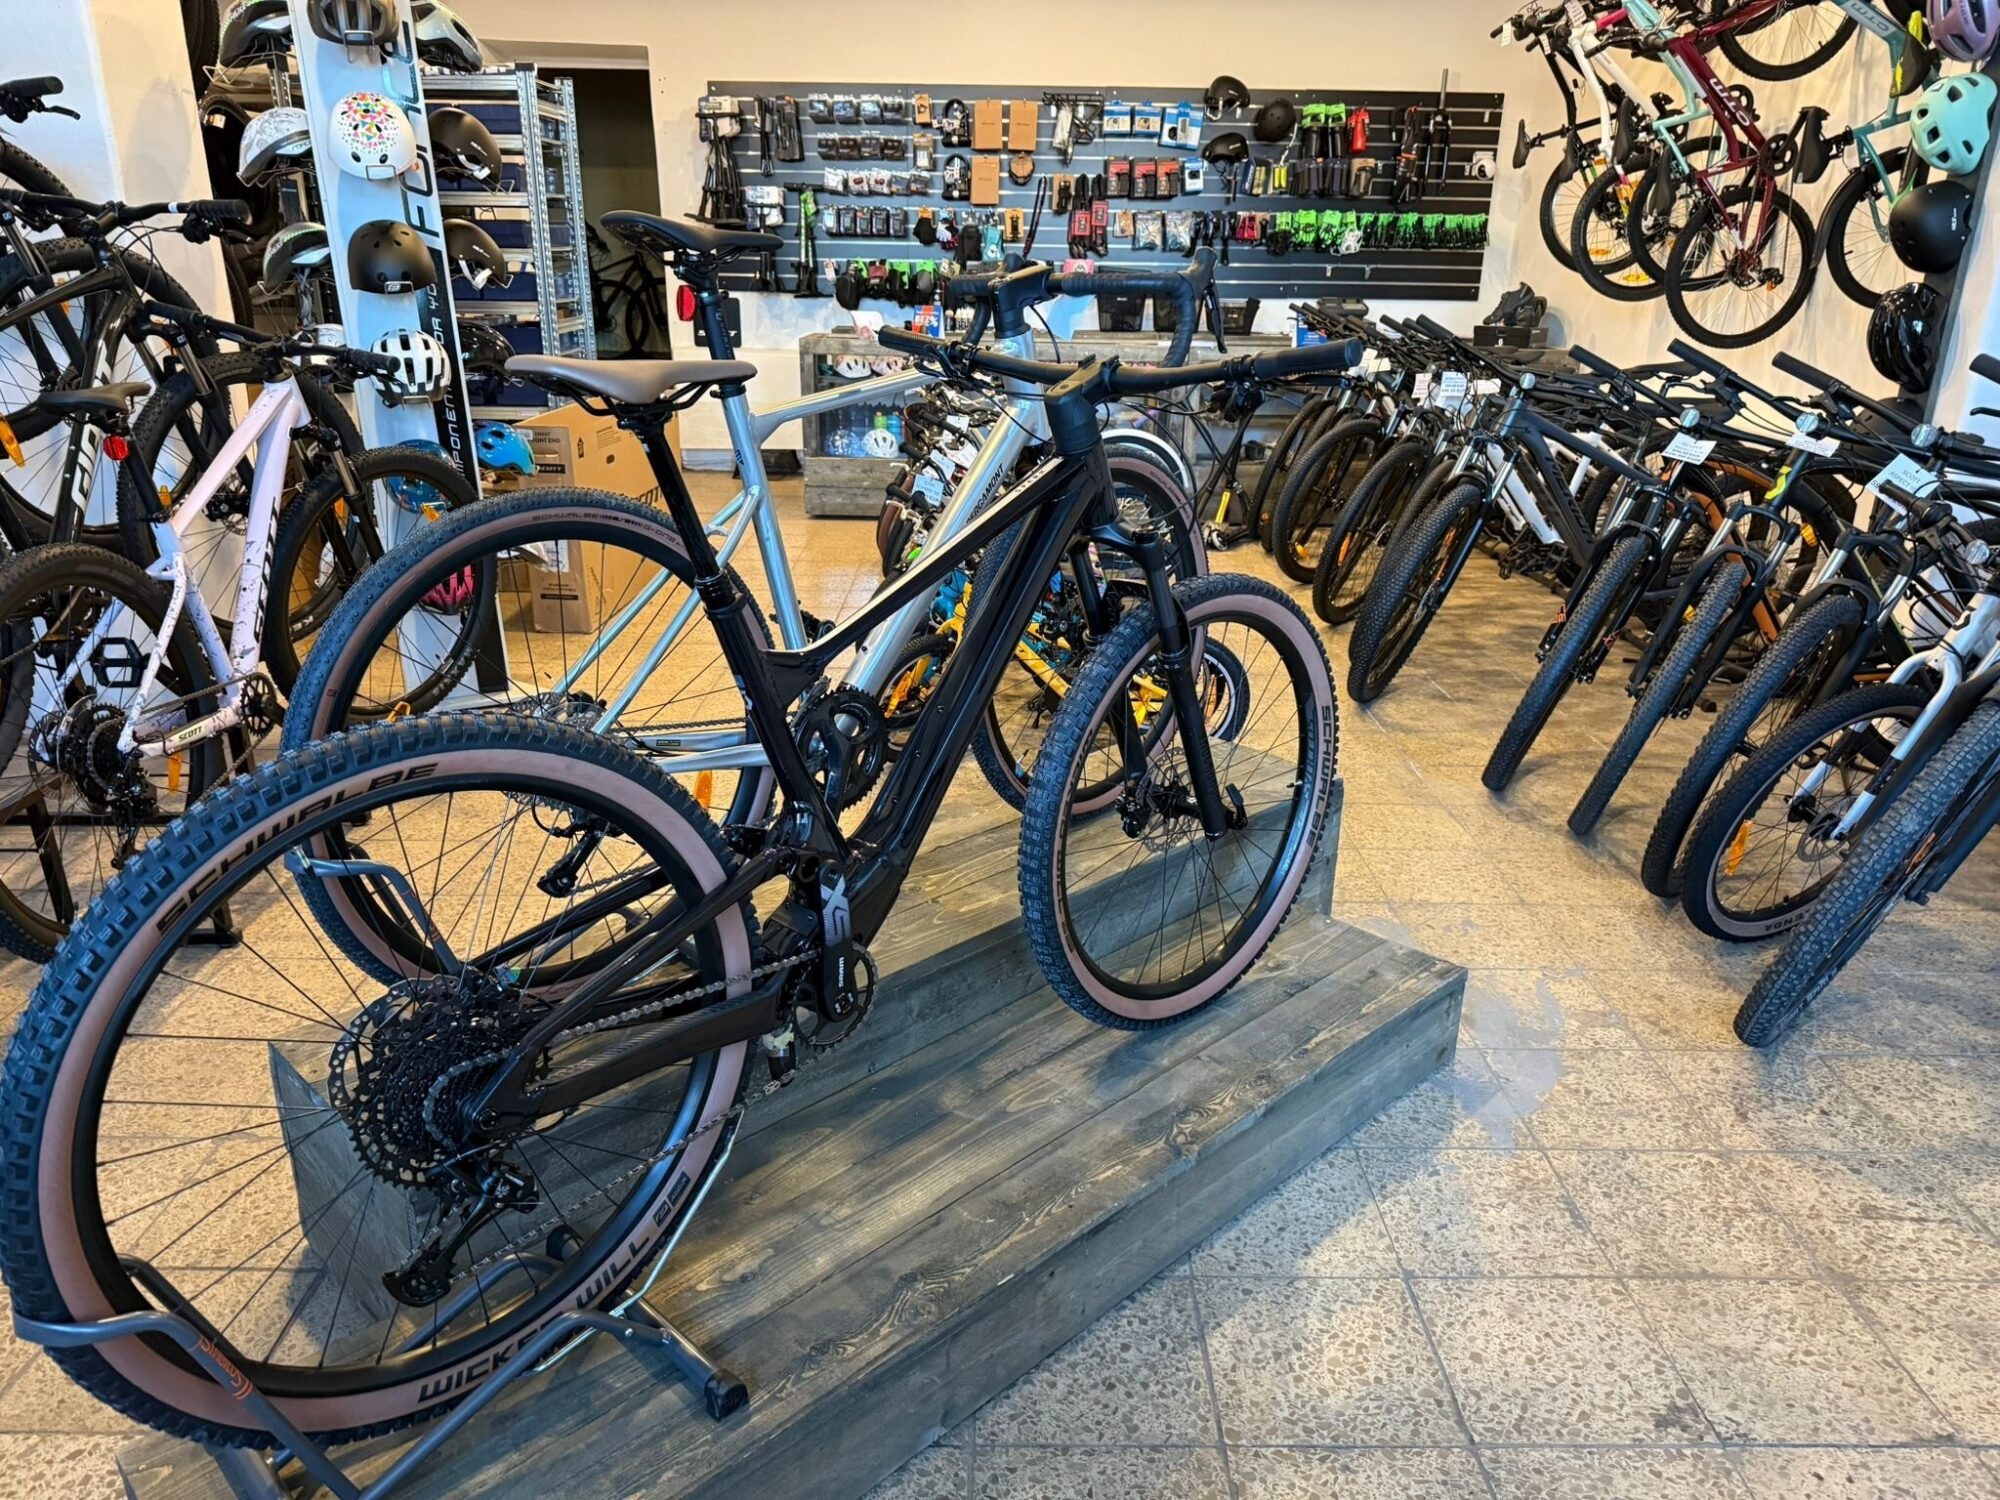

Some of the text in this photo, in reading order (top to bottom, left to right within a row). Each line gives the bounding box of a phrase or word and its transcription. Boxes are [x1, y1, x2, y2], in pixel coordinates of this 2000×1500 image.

[1850, 3, 1889, 32] CTM
[1709, 77, 1750, 127] CTM
[71, 339, 113, 515] GIAT
[178, 726, 203, 741] SCOTT
[1306, 704, 1332, 848] SCHWALBE
[156, 763, 439, 935] SCHWALBE
[576, 1237, 650, 1309] WILL
